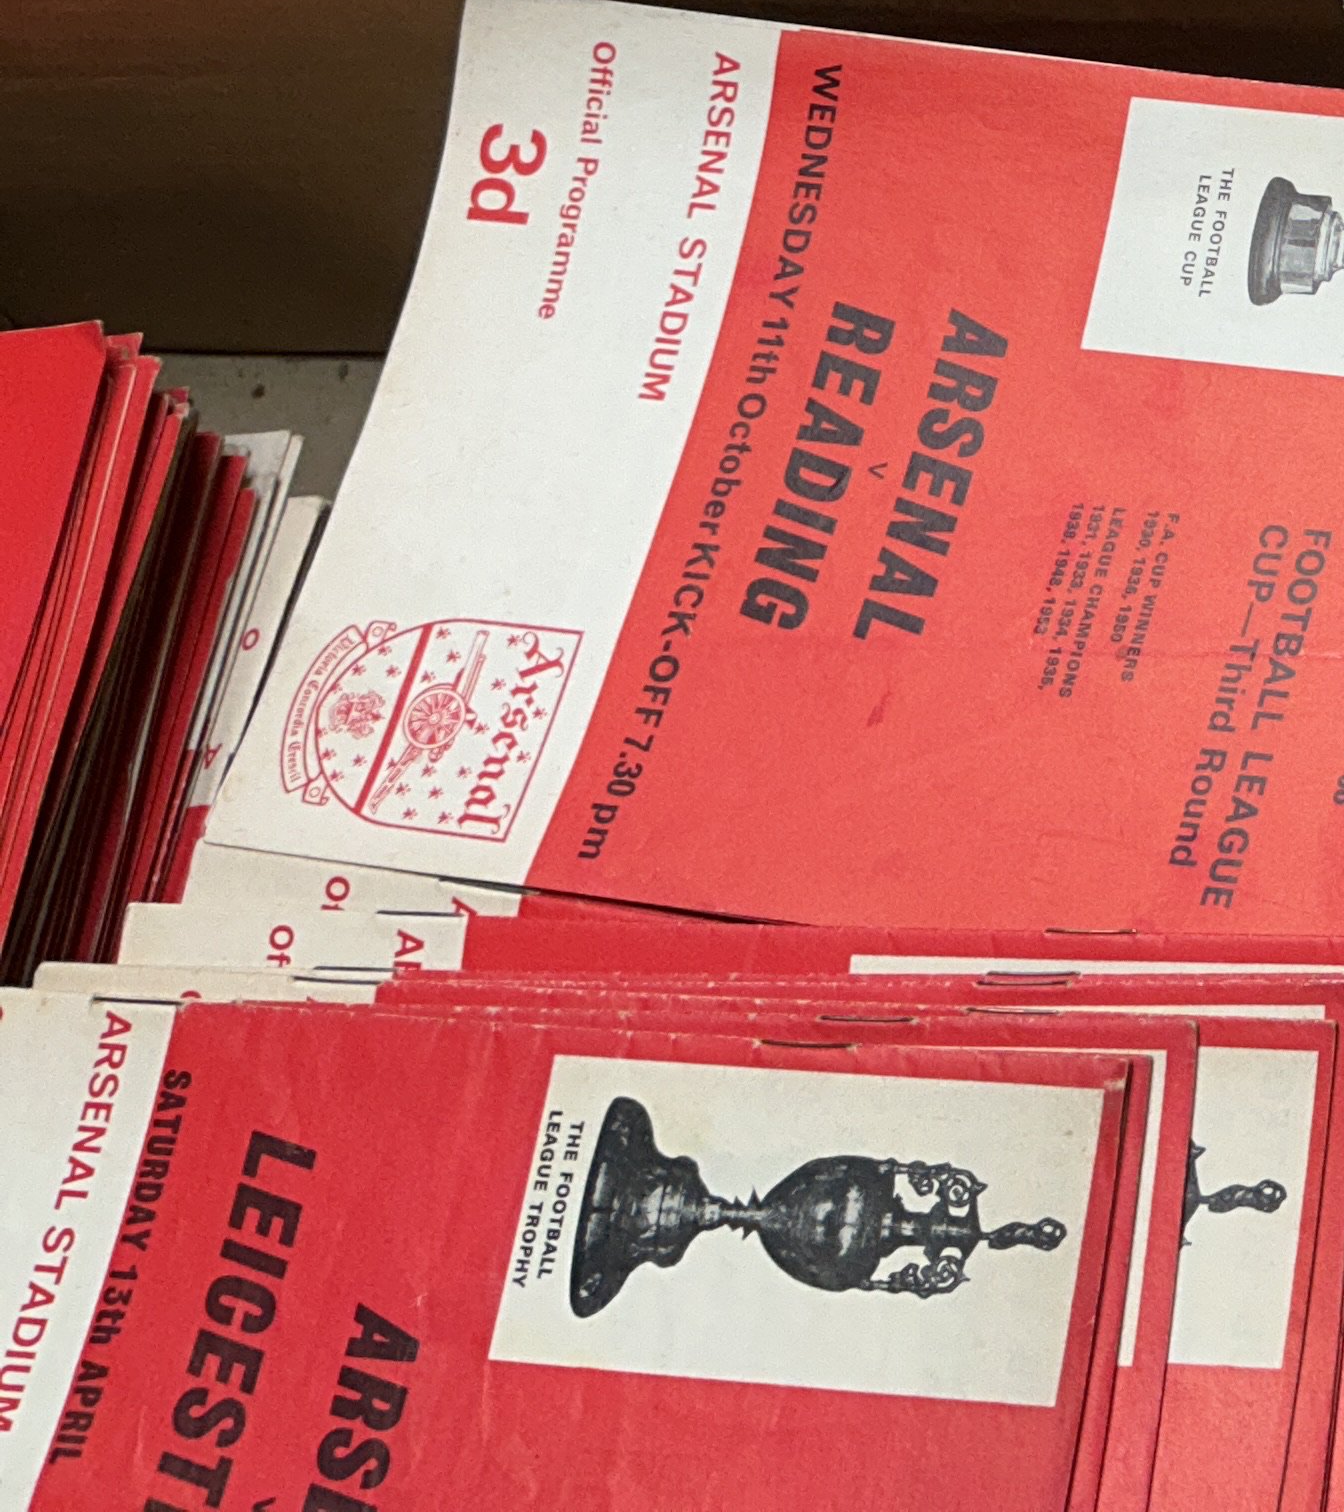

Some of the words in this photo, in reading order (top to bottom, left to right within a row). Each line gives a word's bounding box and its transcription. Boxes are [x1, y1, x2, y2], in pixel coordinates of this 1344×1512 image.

[466, 123, 548, 225] 3d
[591, 41, 618, 144] Official
[685, 51, 742, 221] ARSENAL
[537, 158, 598, 322] Programme
[771, 63, 845, 311] WEDNESDAY
[637, 237, 706, 403] STADIUM
[744, 316, 792, 387] 11th
[699, 393, 768, 543] October
[739, 300, 897, 633] READING
[853, 308, 1009, 641] ARSENAL
[642, 544, 721, 733] KICK-OFF
[1250, 528, 1332, 732] FOOTBALL
[1167, 746, 1210, 868] Round
[53, 1010, 133, 1211] ARSENAL
[121, 1068, 192, 1252] SATURDAY
[87, 1264, 138, 1346] 13th
[511, 1200, 545, 1288] TROPHY
[536, 1170, 575, 1280] FOOTBALL
[145, 1129, 318, 1512] LEICEST
[48, 1359, 110, 1465] APRIL
